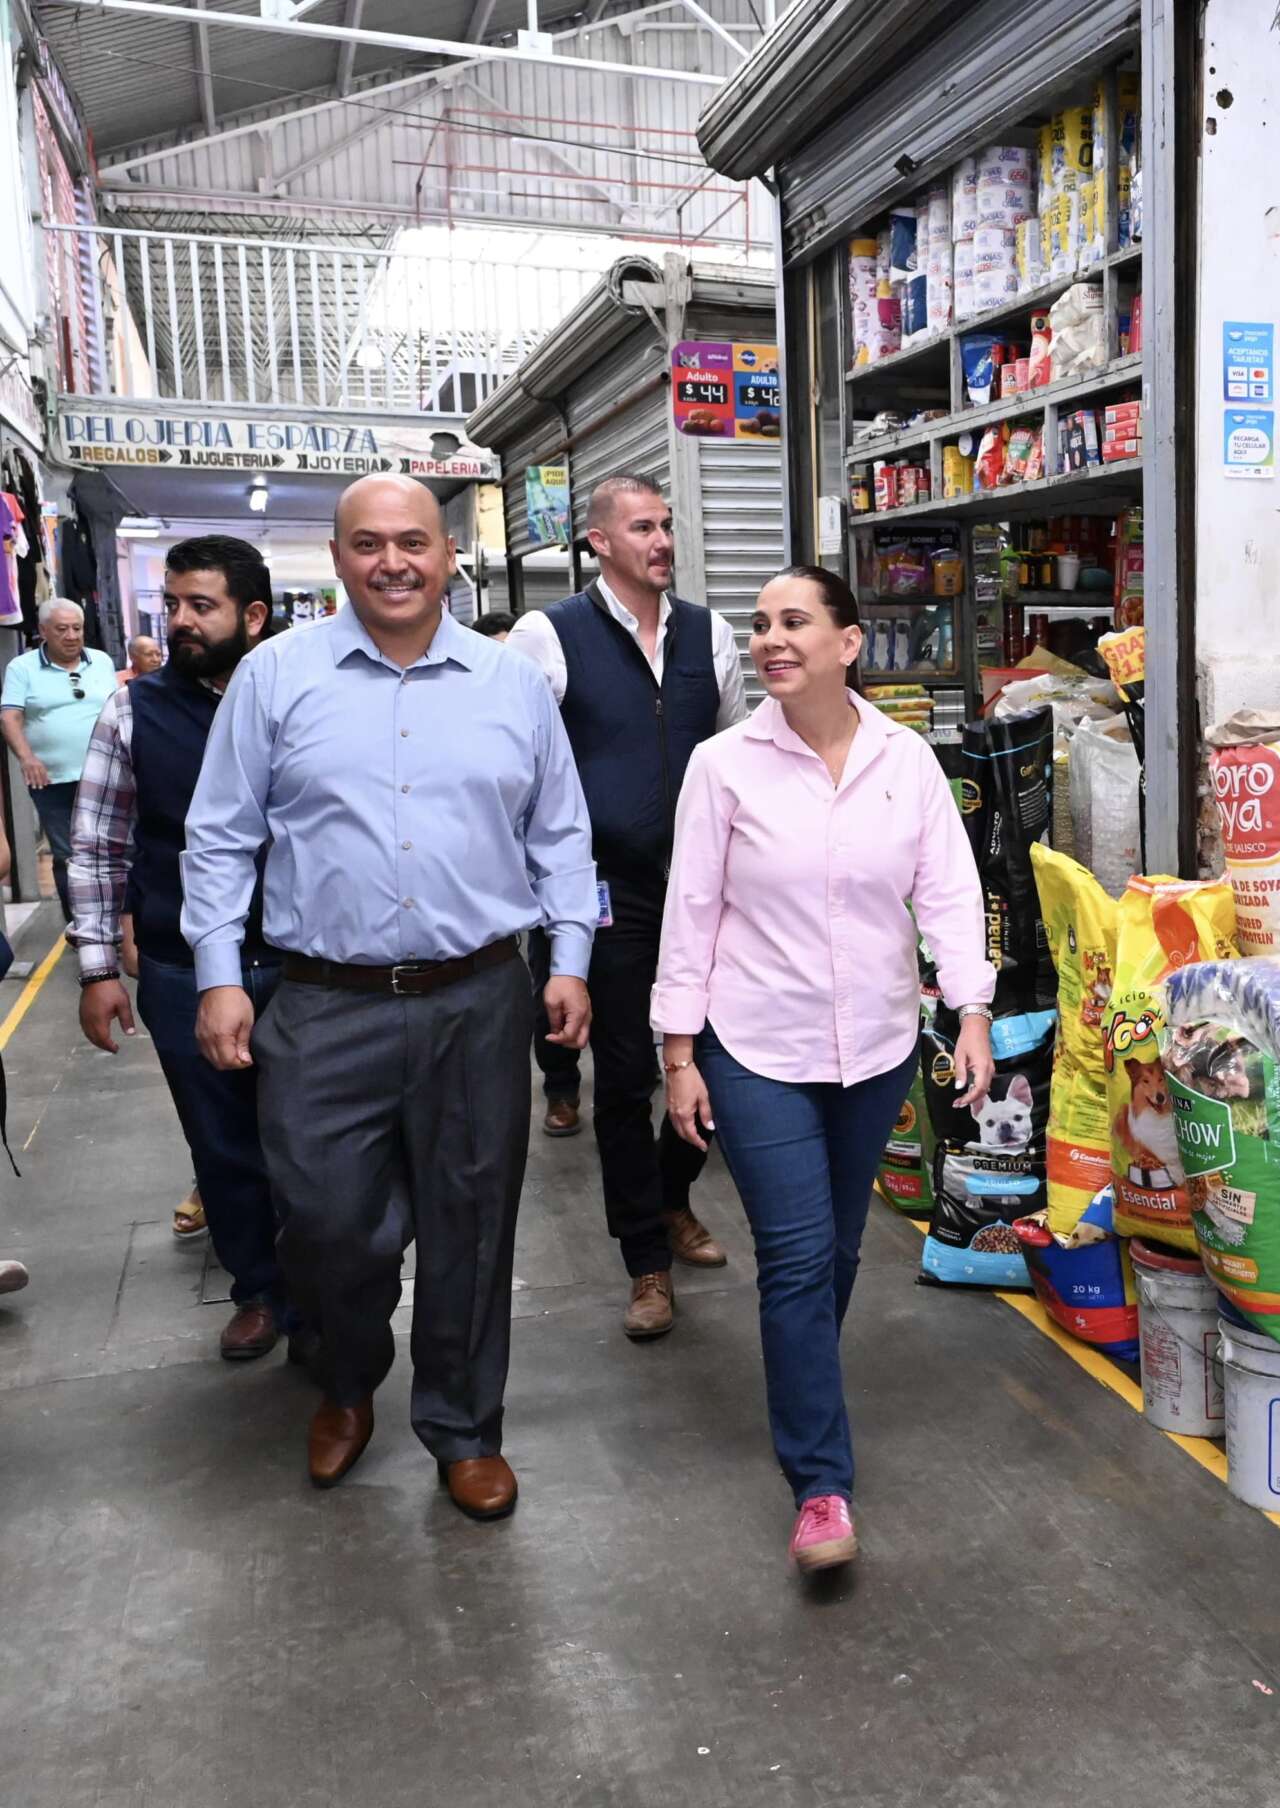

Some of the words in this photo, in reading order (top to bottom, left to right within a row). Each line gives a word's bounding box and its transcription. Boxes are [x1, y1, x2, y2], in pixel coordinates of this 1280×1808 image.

[686, 372, 719, 382] Adulto
[63, 415, 233, 448] RELOJERIA
[247, 422, 379, 454] ESPARZA
[82, 446, 160, 464] REGALOS
[192, 450, 273, 468] JUGUETERIA
[309, 455, 382, 472] JOYERIA
[411, 460, 481, 476] PAPELERIA
[1240, 880, 1251, 891] DE
[974, 1160, 1032, 1172] PREMIUM
[1121, 1185, 1177, 1210] Esencial
[1220, 1189, 1242, 1204] SIN
[1072, 1285, 1085, 1294] 20
[1088, 1285, 1101, 1295] kg
